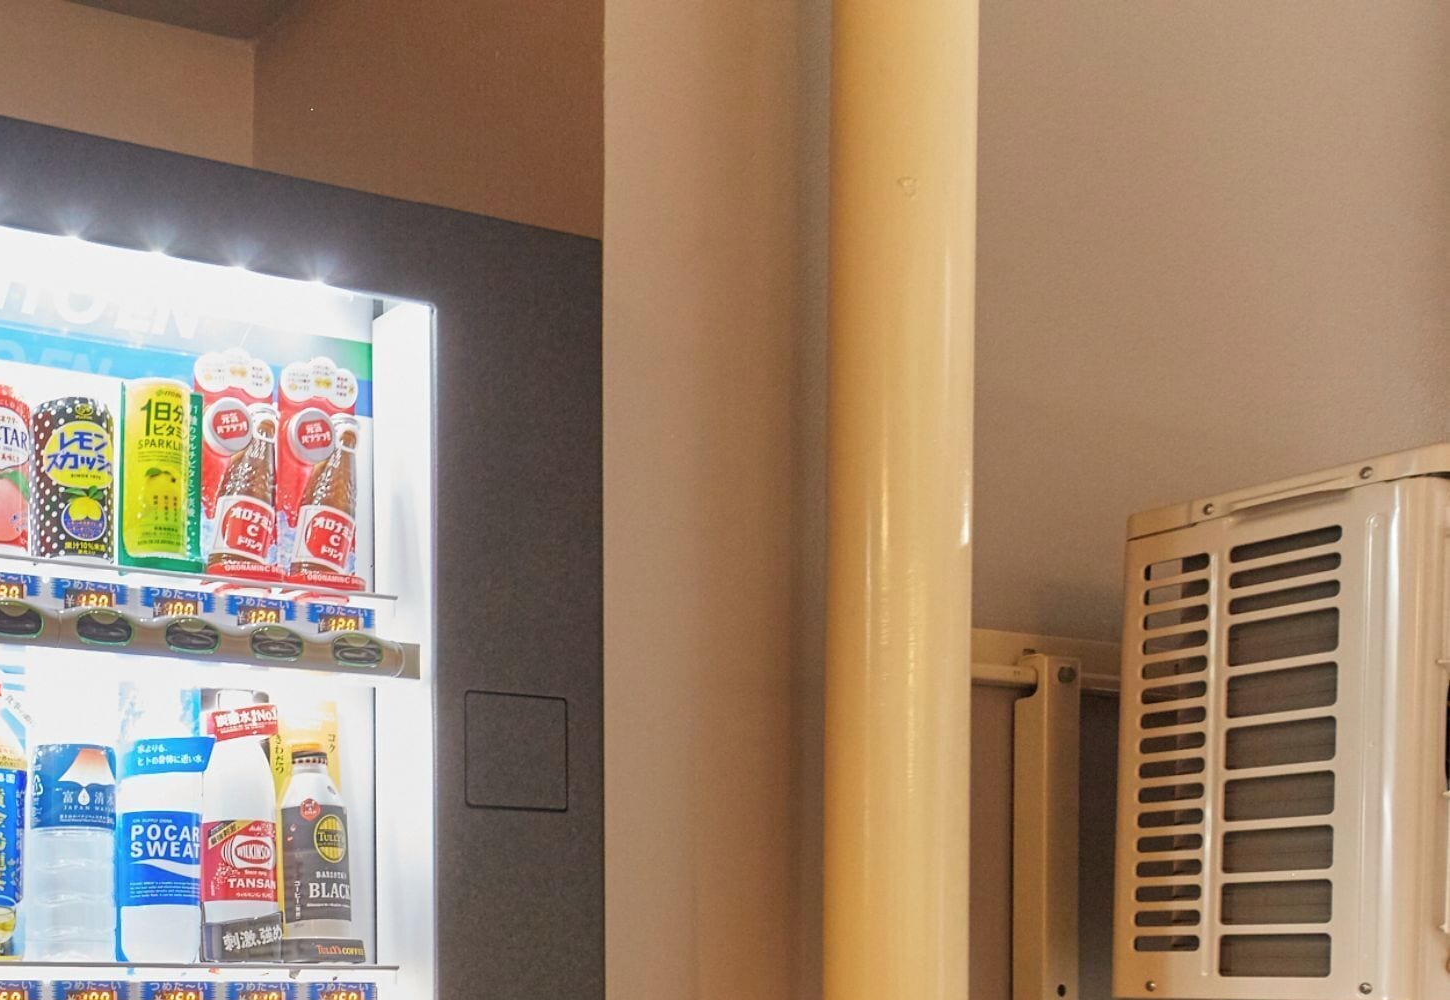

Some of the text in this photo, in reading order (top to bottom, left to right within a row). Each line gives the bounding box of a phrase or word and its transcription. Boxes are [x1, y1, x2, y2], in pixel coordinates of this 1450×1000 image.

[59, 431, 108, 452] レモン
[247, 525, 259, 537] C
[329, 535, 342, 547] C
[130, 841, 200, 859] SWEAT
[309, 882, 351, 899] BLACK
